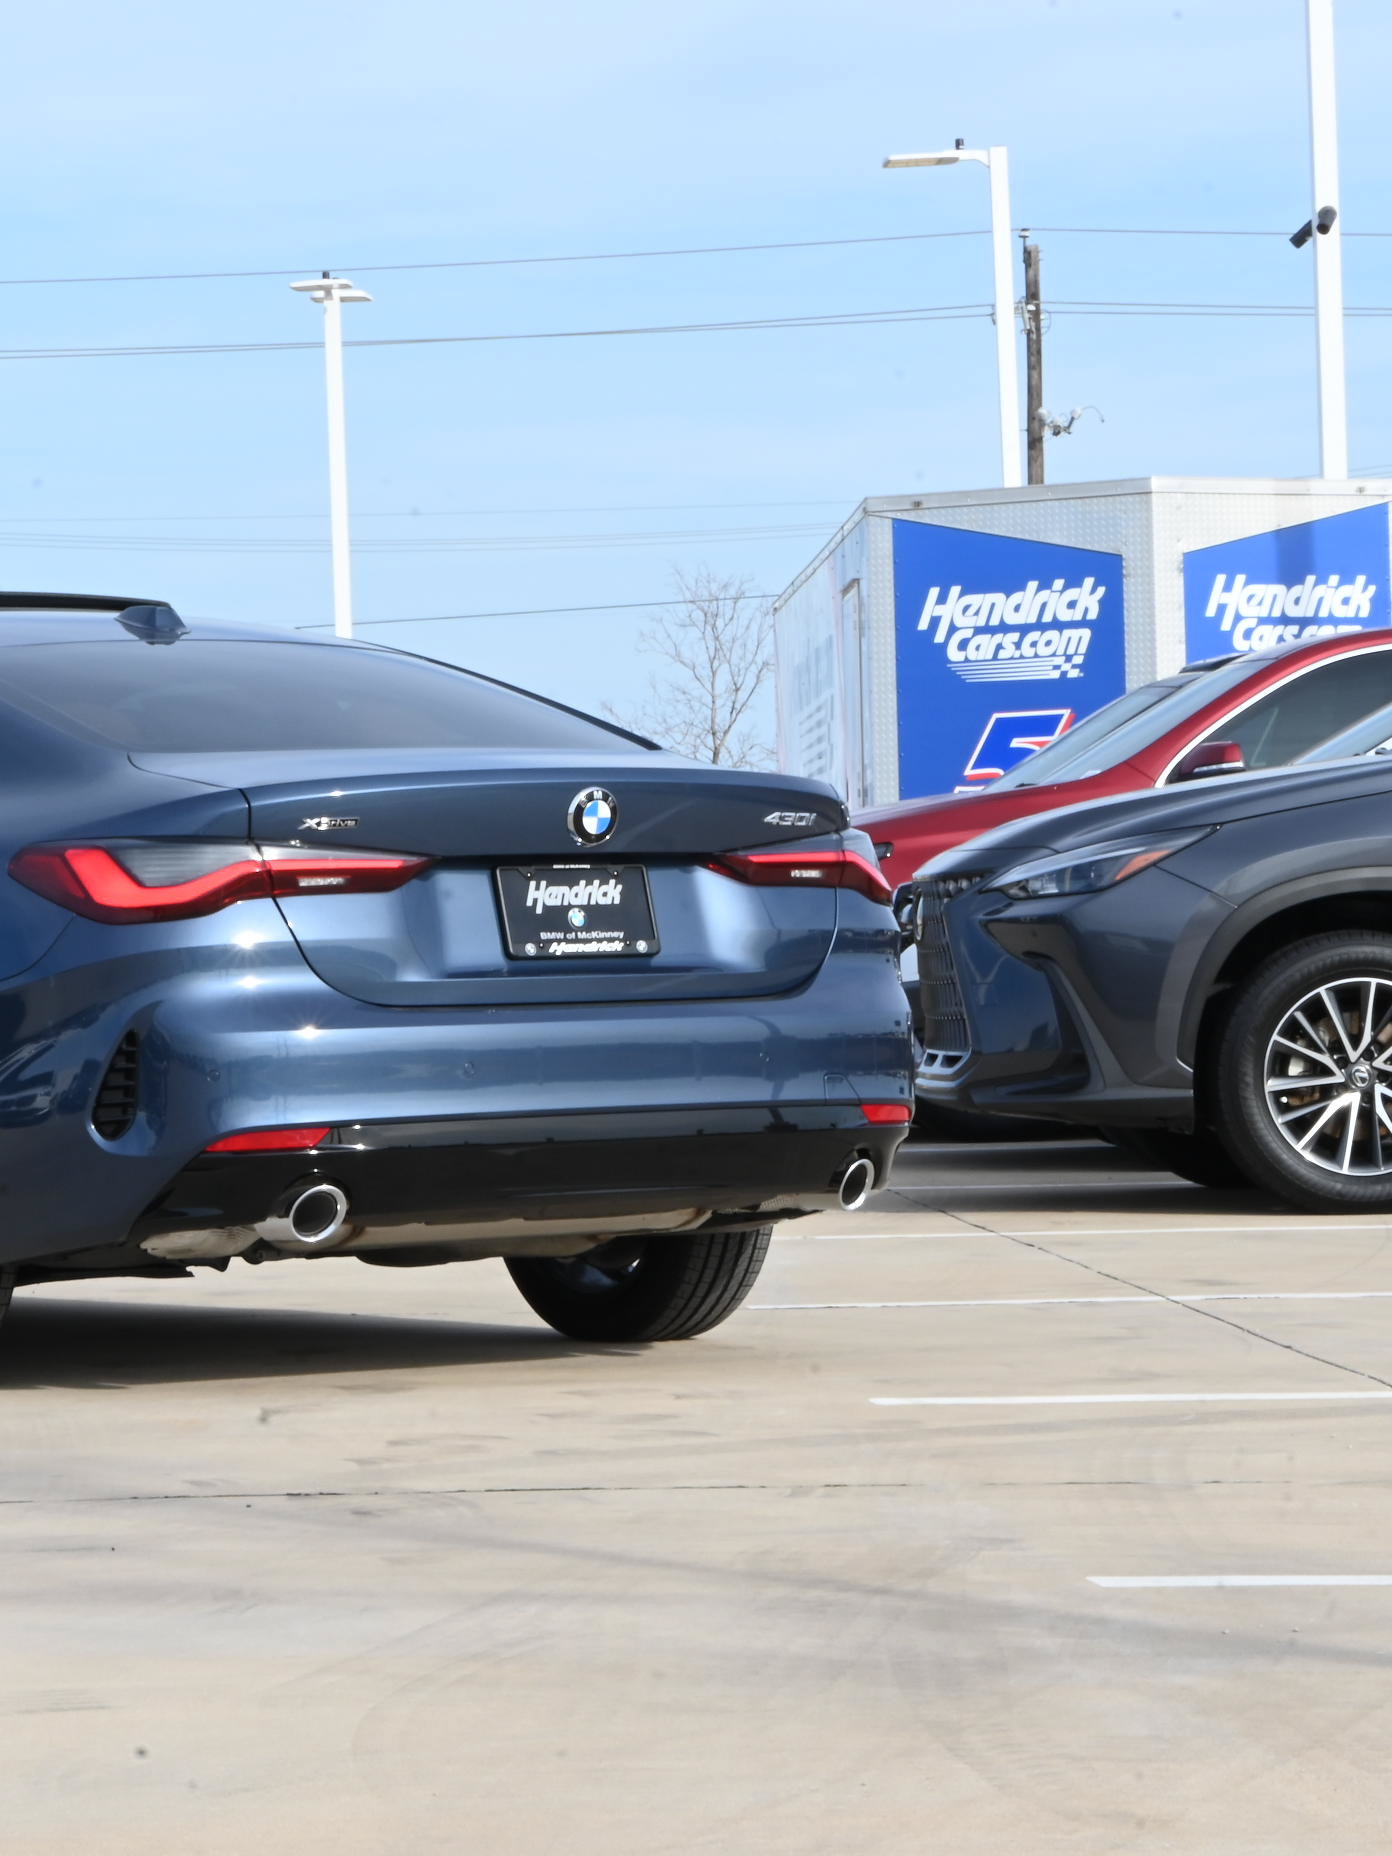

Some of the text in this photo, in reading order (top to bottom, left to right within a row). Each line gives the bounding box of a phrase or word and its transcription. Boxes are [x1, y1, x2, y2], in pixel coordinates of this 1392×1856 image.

[917, 577, 1106, 643] Hendrick
[1205, 574, 1376, 631] Hendrick
[946, 627, 1092, 662] Cars.com
[526, 879, 623, 914] Hendrick
[540, 930, 624, 940] BMW of McKinney
